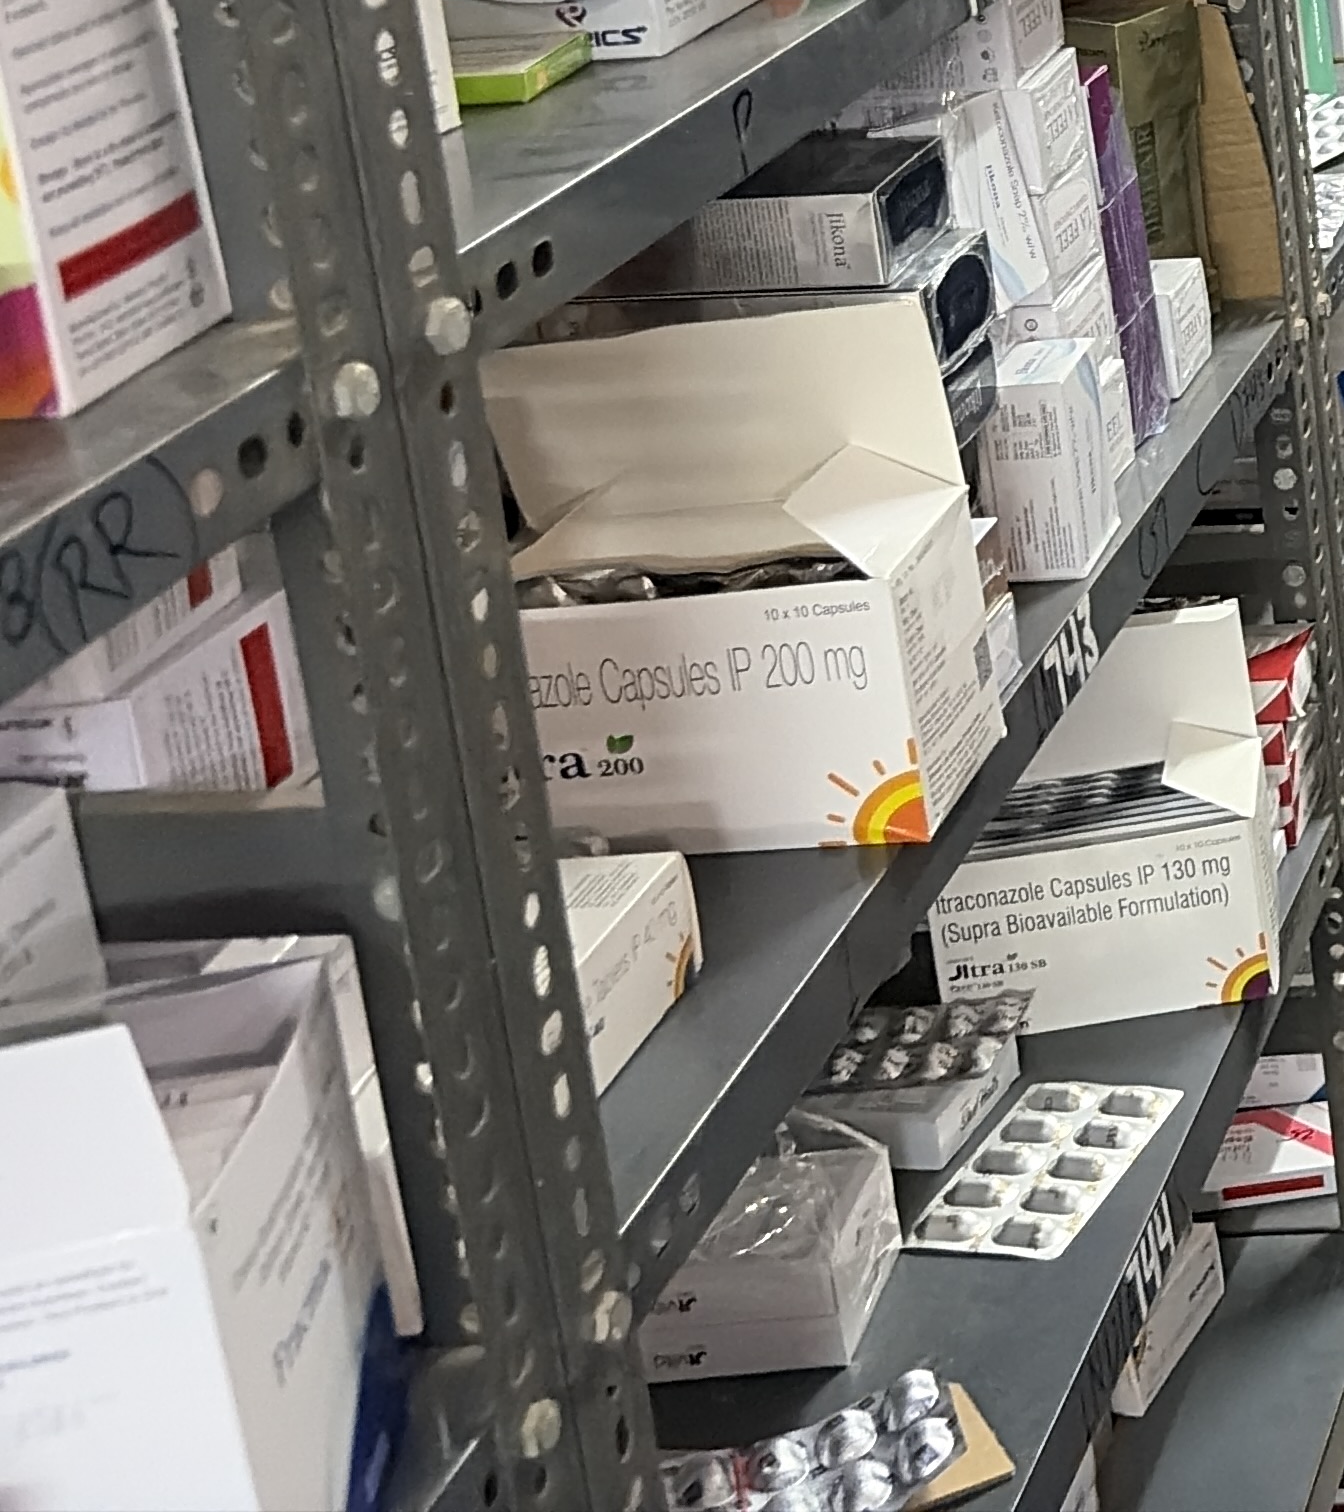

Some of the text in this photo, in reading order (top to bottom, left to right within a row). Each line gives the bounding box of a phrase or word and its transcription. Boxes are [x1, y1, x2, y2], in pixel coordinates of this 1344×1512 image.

[764, 598, 870, 621] 10 10 Capsules
[600, 642, 868, 713] Capsules IP 200 mg
[598, 757, 644, 778] 200
[1050, 855, 1231, 907] Capsules IP 130 mg
[941, 883, 1231, 948] (Supra Bioavailable Formulation)
